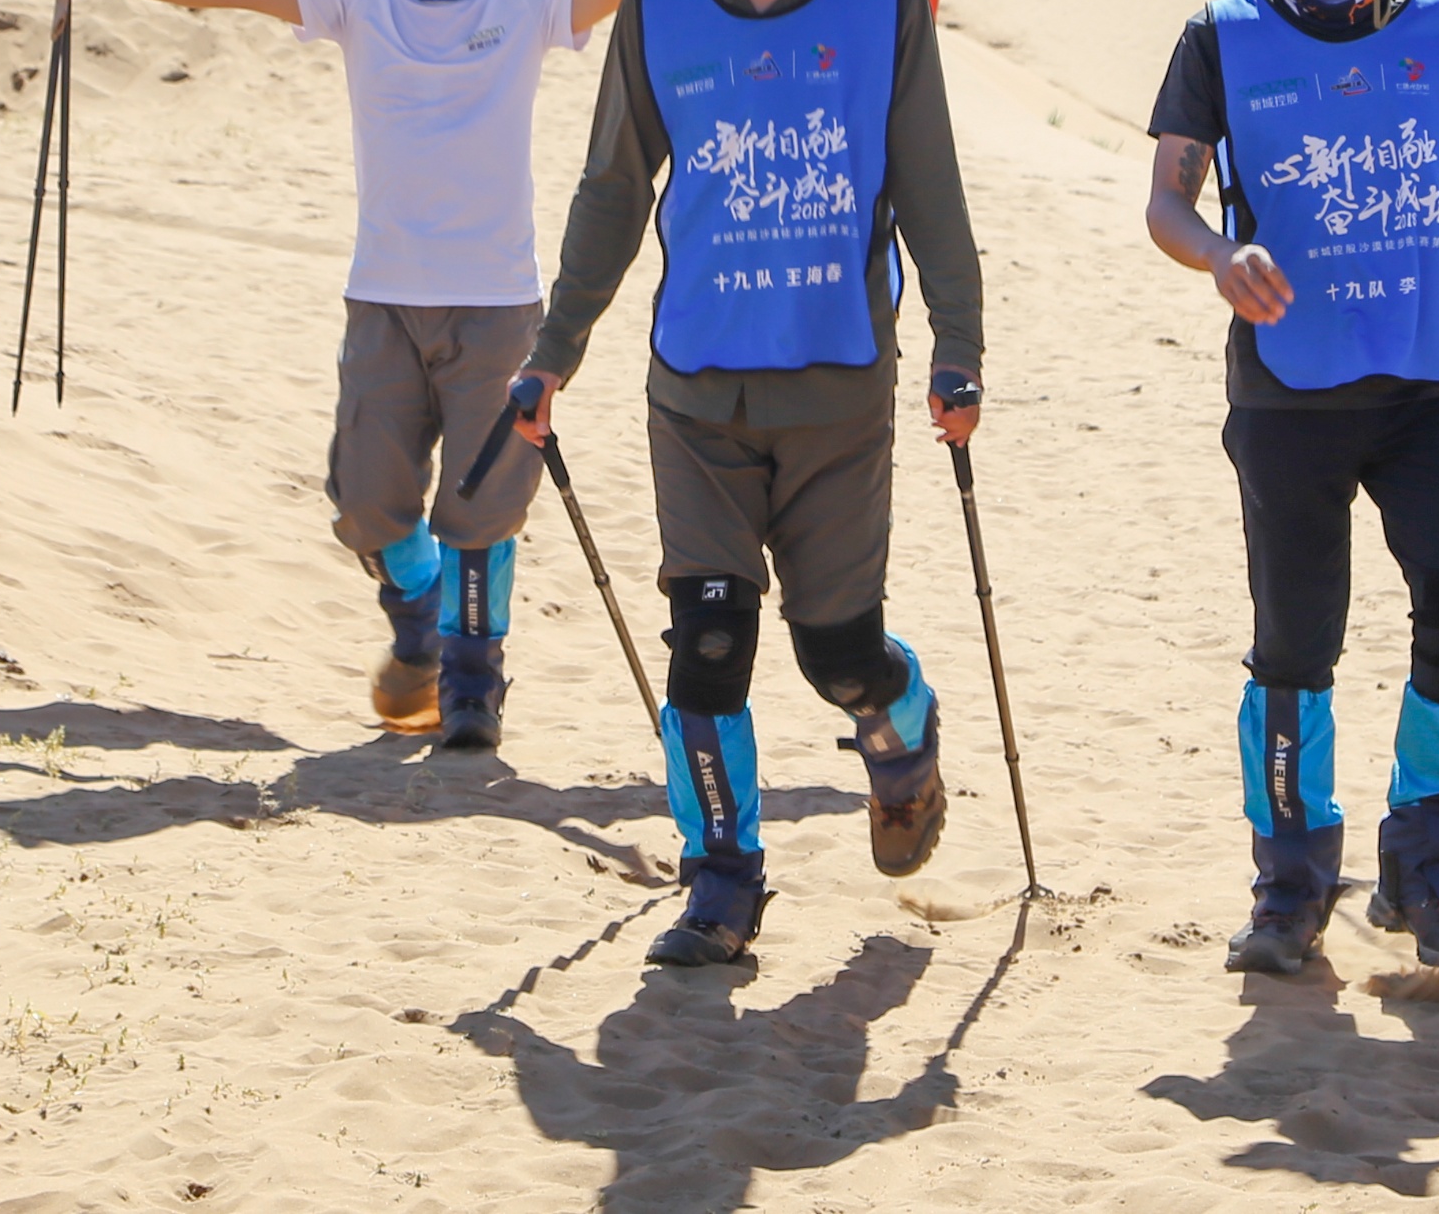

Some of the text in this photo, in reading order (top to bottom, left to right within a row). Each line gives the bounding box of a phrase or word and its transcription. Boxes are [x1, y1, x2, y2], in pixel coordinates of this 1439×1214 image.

[713, 268, 774, 293] 十九队
[1326, 276, 1417, 302] 十九队 李
